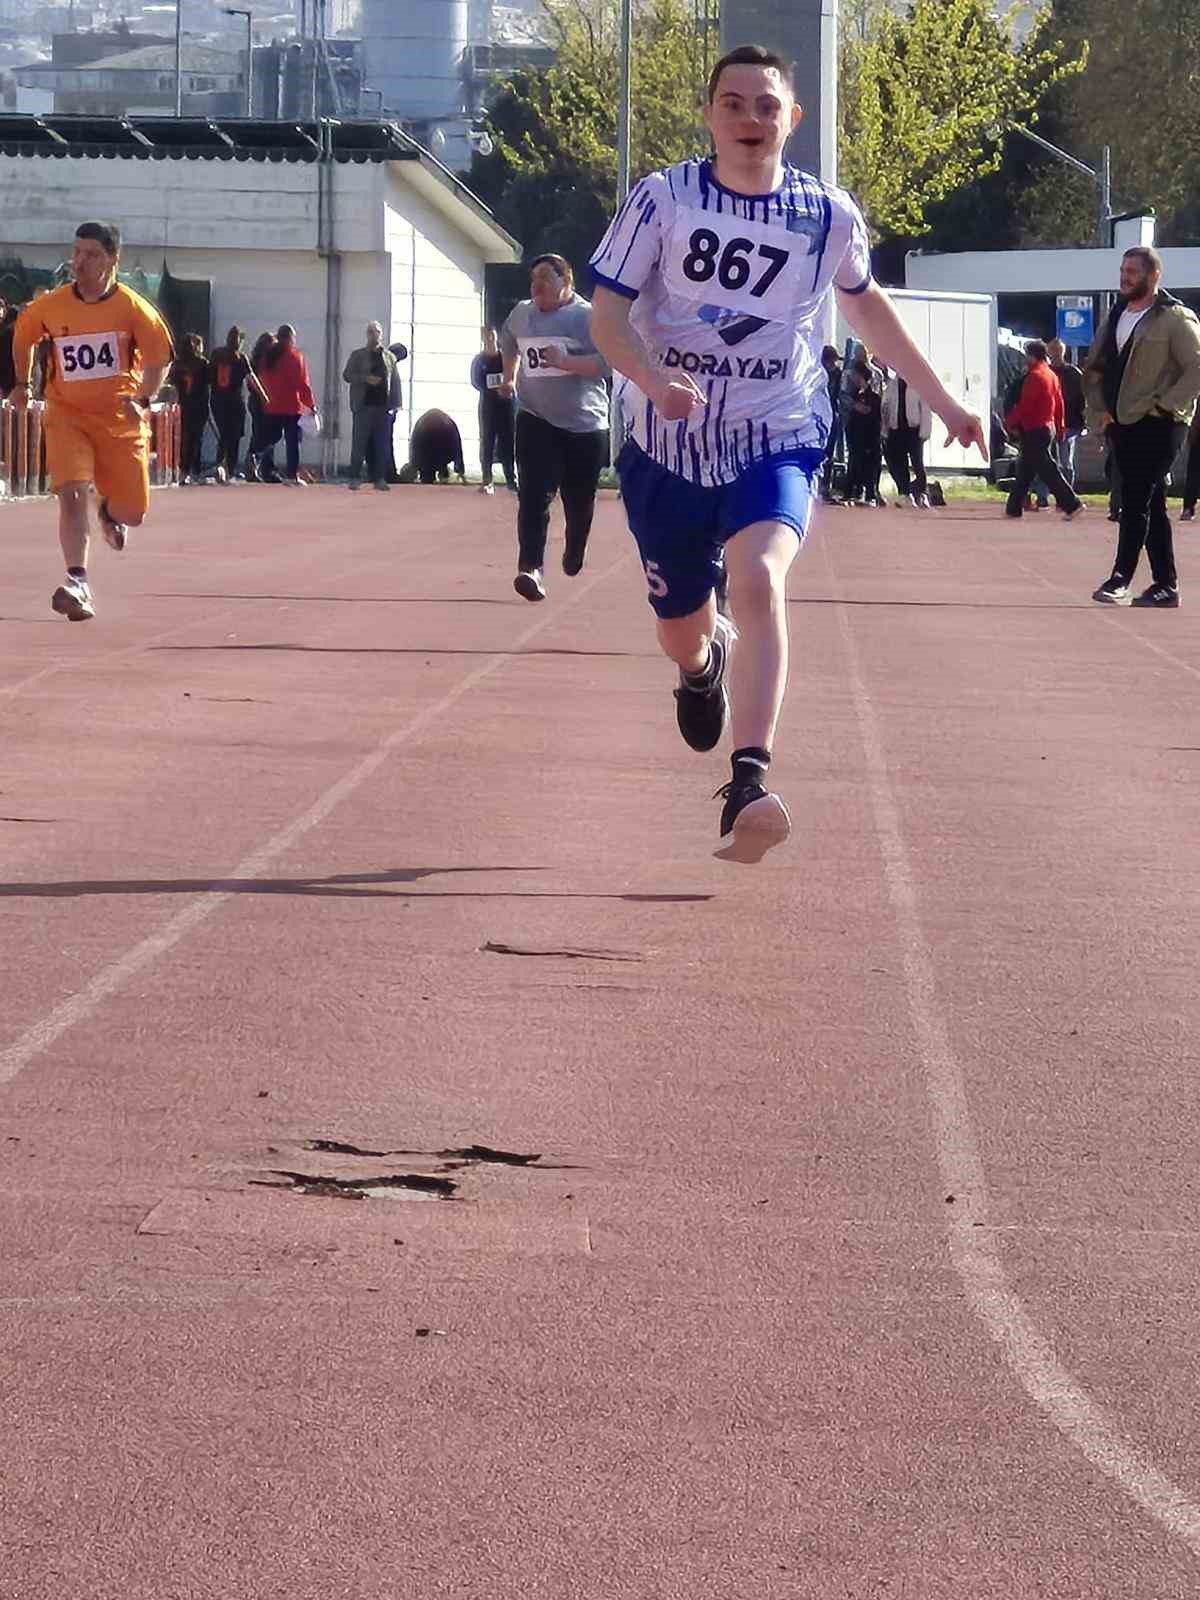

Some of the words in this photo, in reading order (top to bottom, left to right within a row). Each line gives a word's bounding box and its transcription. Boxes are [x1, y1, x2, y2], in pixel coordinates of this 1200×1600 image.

[683, 228, 789, 298] 867
[63, 342, 114, 372] 504
[646, 559, 668, 597] 5
